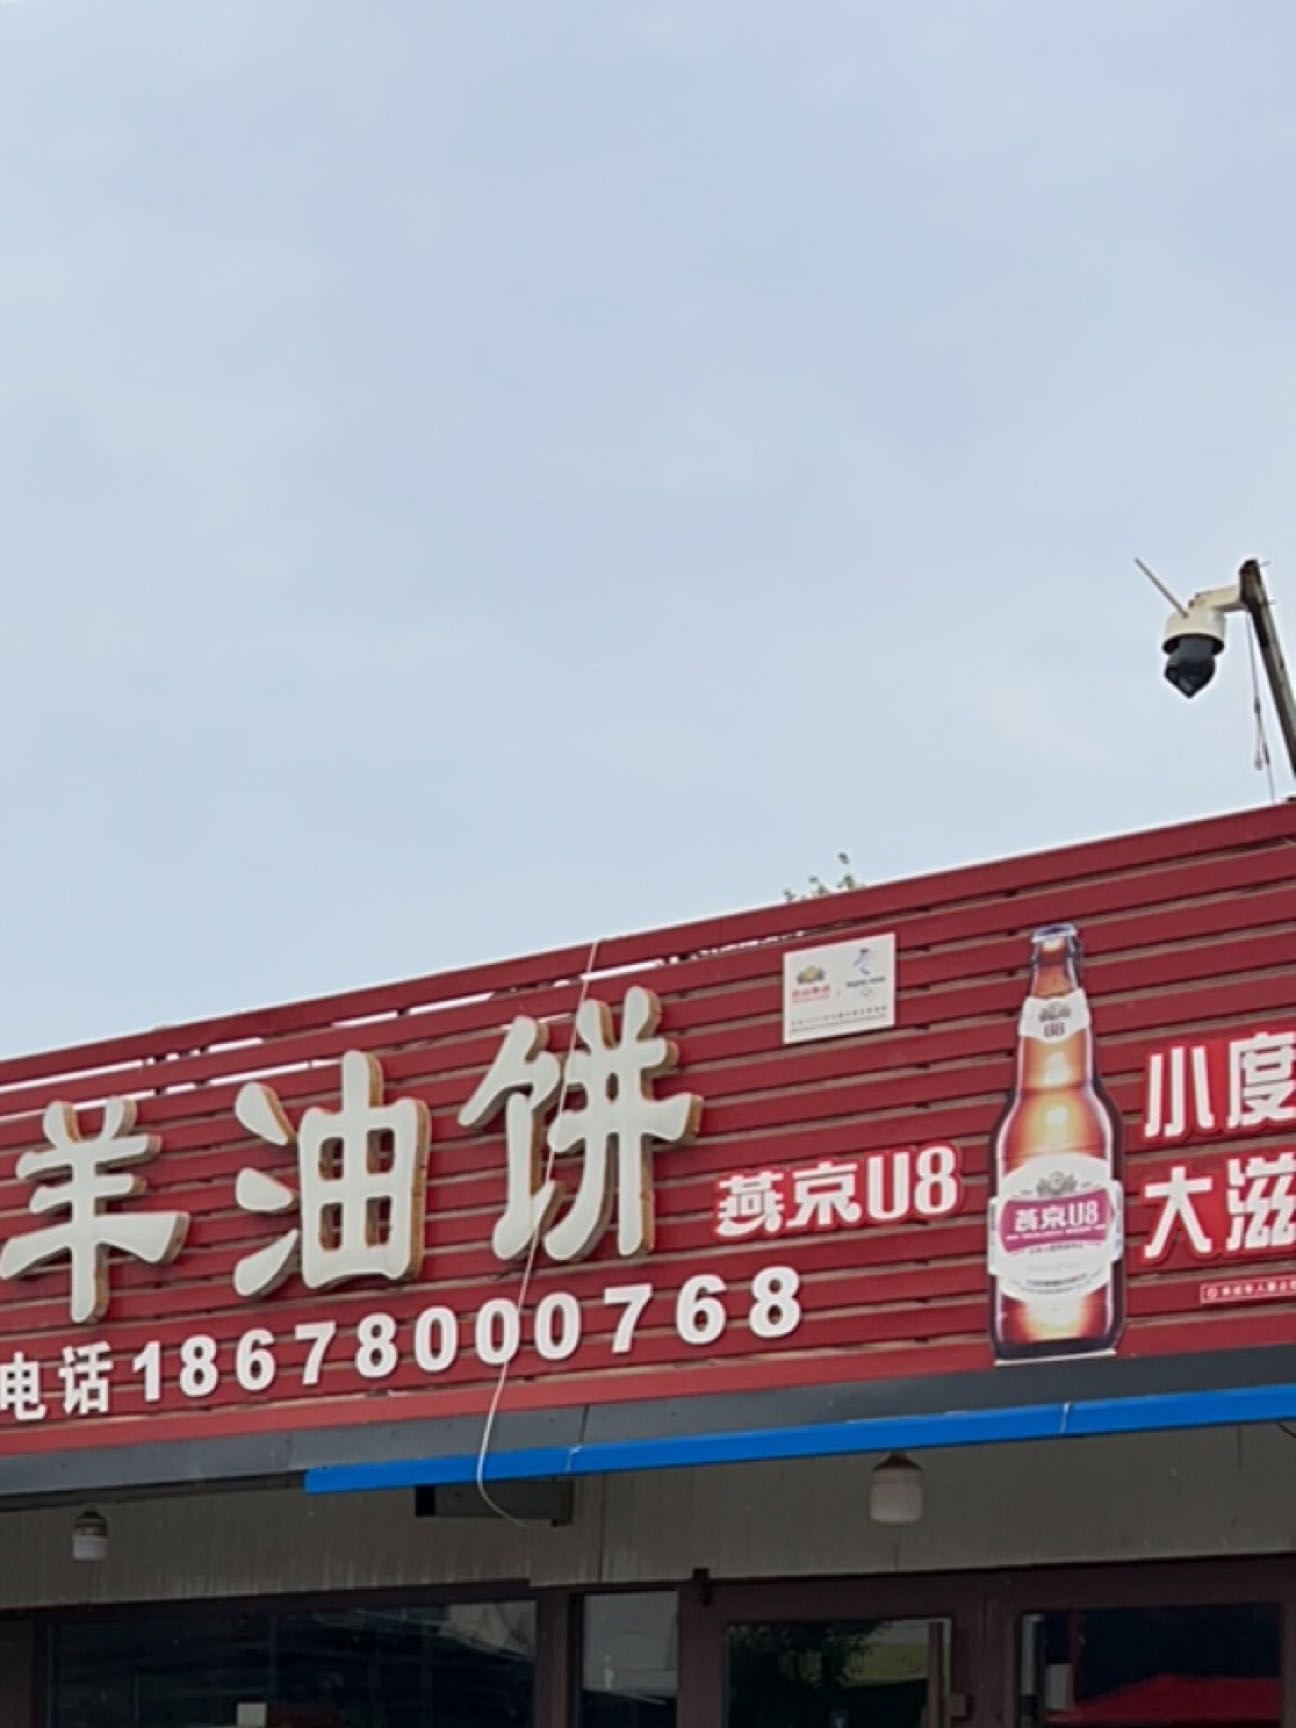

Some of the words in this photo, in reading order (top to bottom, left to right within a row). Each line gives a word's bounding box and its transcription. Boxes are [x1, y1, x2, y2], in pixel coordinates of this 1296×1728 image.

[1144, 1031, 1296, 1138] 小度
[715, 1145, 959, 1237] 燕京U8
[1144, 1152, 1296, 1260] 大滋
